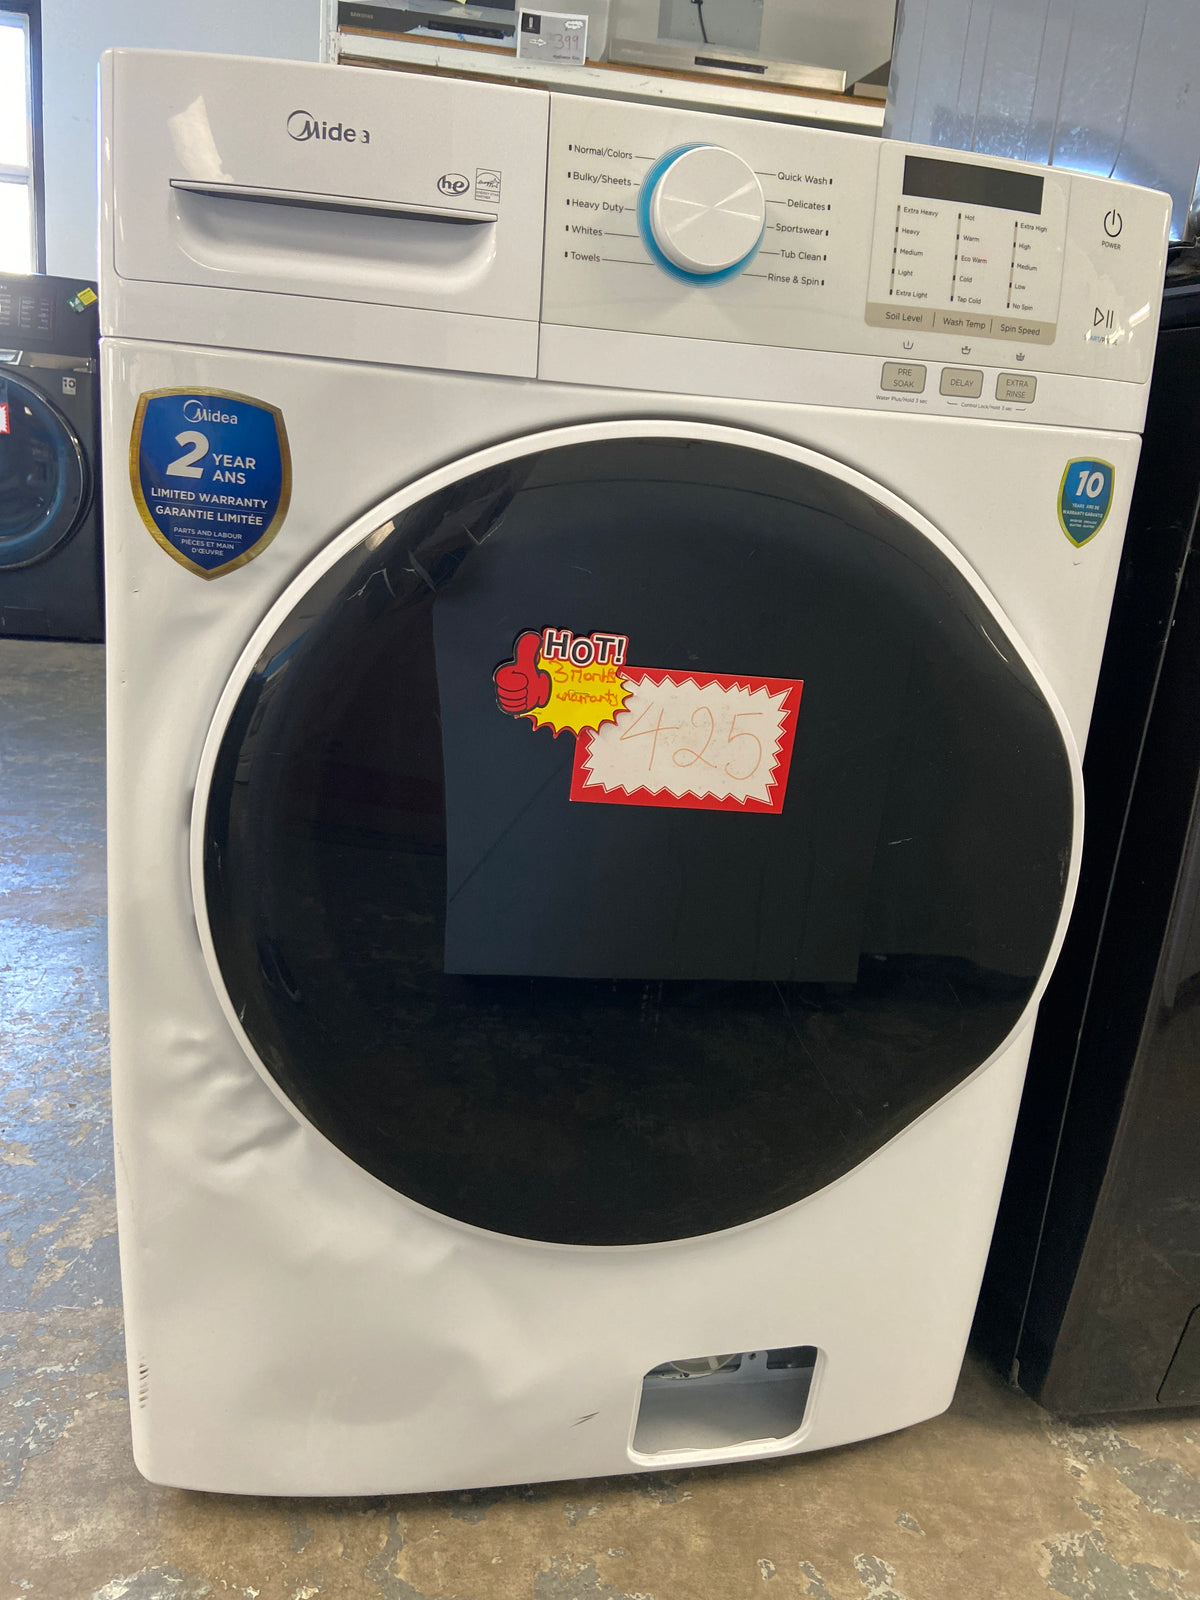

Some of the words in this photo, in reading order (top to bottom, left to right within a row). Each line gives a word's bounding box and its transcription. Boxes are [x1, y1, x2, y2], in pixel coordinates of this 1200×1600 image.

[552, 33, 579, 50] 399
[574, 144, 633, 159] Normal/Colors
[573, 171, 632, 187] Bulky/Sheets
[778, 172, 802, 182] Quick
[805, 175, 828, 185] Wash
[572, 198, 600, 211] Heavy
[602, 202, 624, 213] Duty
[787, 198, 826, 211] Delicates
[904, 206, 919, 214] Extra
[920, 209, 938, 217] Heavy
[964, 214, 975, 222] Hot
[572, 225, 603, 236] Whites
[776, 223, 824, 236] Sportswear
[902, 228, 920, 236] Heavy
[1020, 222, 1034, 230] Extra
[1036, 225, 1048, 233] High
[963, 234, 980, 242] Warm
[1018, 243, 1031, 251] High
[1102, 240, 1121, 250] POWER
[571, 251, 601, 262] Towels
[780, 250, 796, 259] Tub
[798, 252, 822, 261] Clean
[900, 248, 923, 256] Medium
[898, 269, 913, 277] Light
[1016, 264, 1038, 272] Medium
[768, 273, 791, 284] Rinse
[792, 276, 798, 284] &
[801, 276, 820, 286] Spin
[912, 290, 928, 298] Light
[885, 312, 900, 321] Soil
[902, 312, 923, 323] Level
[942, 317, 964, 328] Wash
[966, 319, 986, 330] Temp
[1000, 324, 1017, 334] Spin
[1018, 326, 1041, 336] Speed
[898, 368, 912, 376] PRE
[893, 379, 914, 388] SOAK
[950, 378, 975, 388] DELAY
[1006, 380, 1029, 388] EXTRA
[1006, 390, 1026, 399] RINSE
[183, 399, 238, 425] Midea
[166, 430, 210, 479] 2
[212, 453, 256, 470] YEAR
[212, 470, 247, 485] ANS
[1076, 470, 1104, 499] 10
[151, 487, 196, 501] LIMITED
[199, 493, 268, 509] WARRANTY
[156, 505, 214, 521] GARANTIE
[217, 512, 264, 526] LIMITÉE
[174, 526, 196, 535] PARTS
[214, 532, 243, 540] LABOUR
[216, 542, 234, 550] MAIN
[544, 630, 626, 666] HOT!
[619, 701, 763, 781] 425
